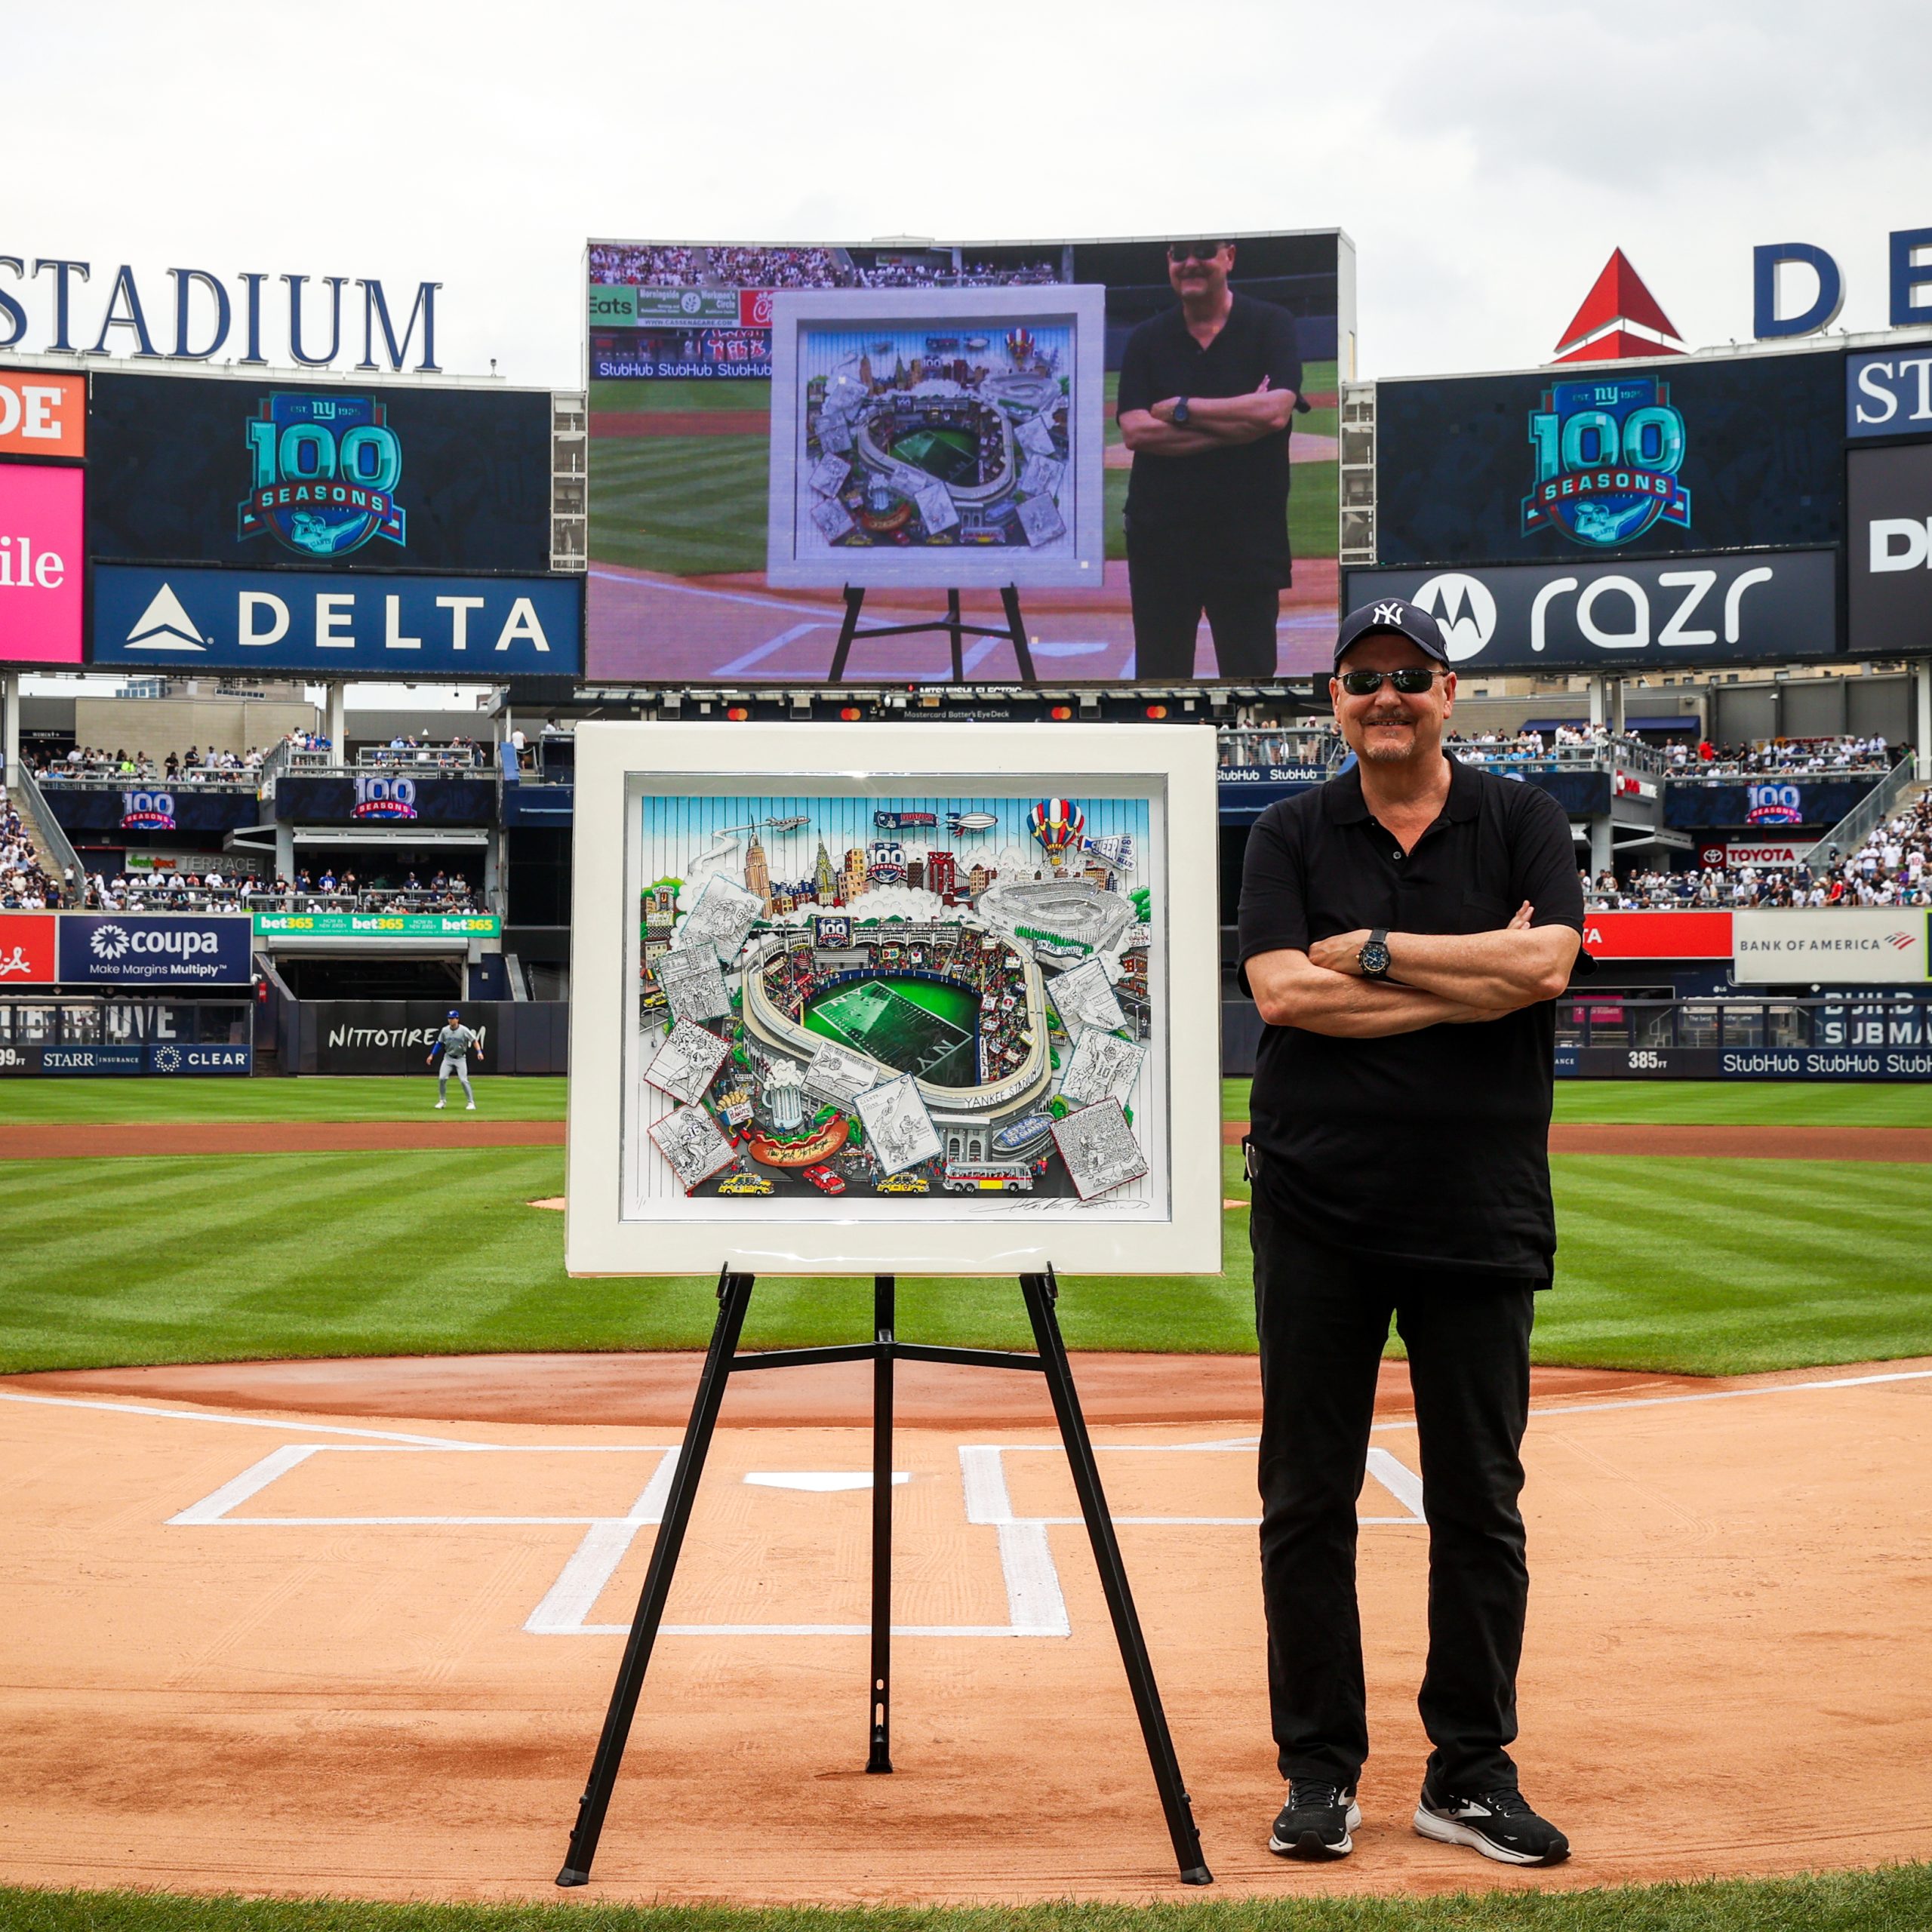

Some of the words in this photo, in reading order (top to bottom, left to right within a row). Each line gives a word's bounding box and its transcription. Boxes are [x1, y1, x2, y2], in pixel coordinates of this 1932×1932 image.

[1754, 227, 1932, 340] DE
[0, 255, 444, 373] STADIUM
[600, 362, 654, 376] StubHub
[658, 362, 712, 377] StubHub
[718, 362, 771, 377] StubHub
[1534, 407, 1683, 483] 100
[251, 422, 398, 492] 100
[1545, 473, 1668, 500] SEASONS
[262, 486, 383, 512] SEASONS
[1372, 602, 1404, 626] NY
[1531, 567, 1774, 651] razr
[238, 591, 551, 651] DELTA
[1269, 768, 1317, 780] StubHub
[354, 778, 414, 802] 100
[1747, 785, 1800, 808] 100
[122, 792, 174, 815] 100
[359, 801, 409, 813] SEASONS
[127, 813, 169, 823] SEASONS
[869, 849, 906, 867] 100
[1117, 856, 1134, 868] BLUE
[1728, 848, 1795, 861] TOYOTA
[180, 855, 257, 873] TERRACE
[261, 915, 314, 929] bet365
[352, 917, 405, 930] bet365
[442, 918, 494, 931] bet365
[820, 923, 847, 936] 100
[131, 931, 219, 960] coupa
[1740, 940, 1782, 951] BANK
[1786, 940, 1805, 950] OF
[1810, 939, 1880, 950] AMERICA
[90, 964, 120, 974] Make
[123, 964, 168, 977] Margins
[43, 1054, 95, 1067] STARR
[188, 1053, 246, 1065] CLEAR
[1723, 1054, 1800, 1072] StubHub
[1807, 1054, 1880, 1072] StubHub
[964, 1090, 1004, 1109] YANKEE
[1009, 1069, 1038, 1097] STADIUM
[734, 1103, 747, 1112] HOT
[780, 1148, 795, 1162] York
